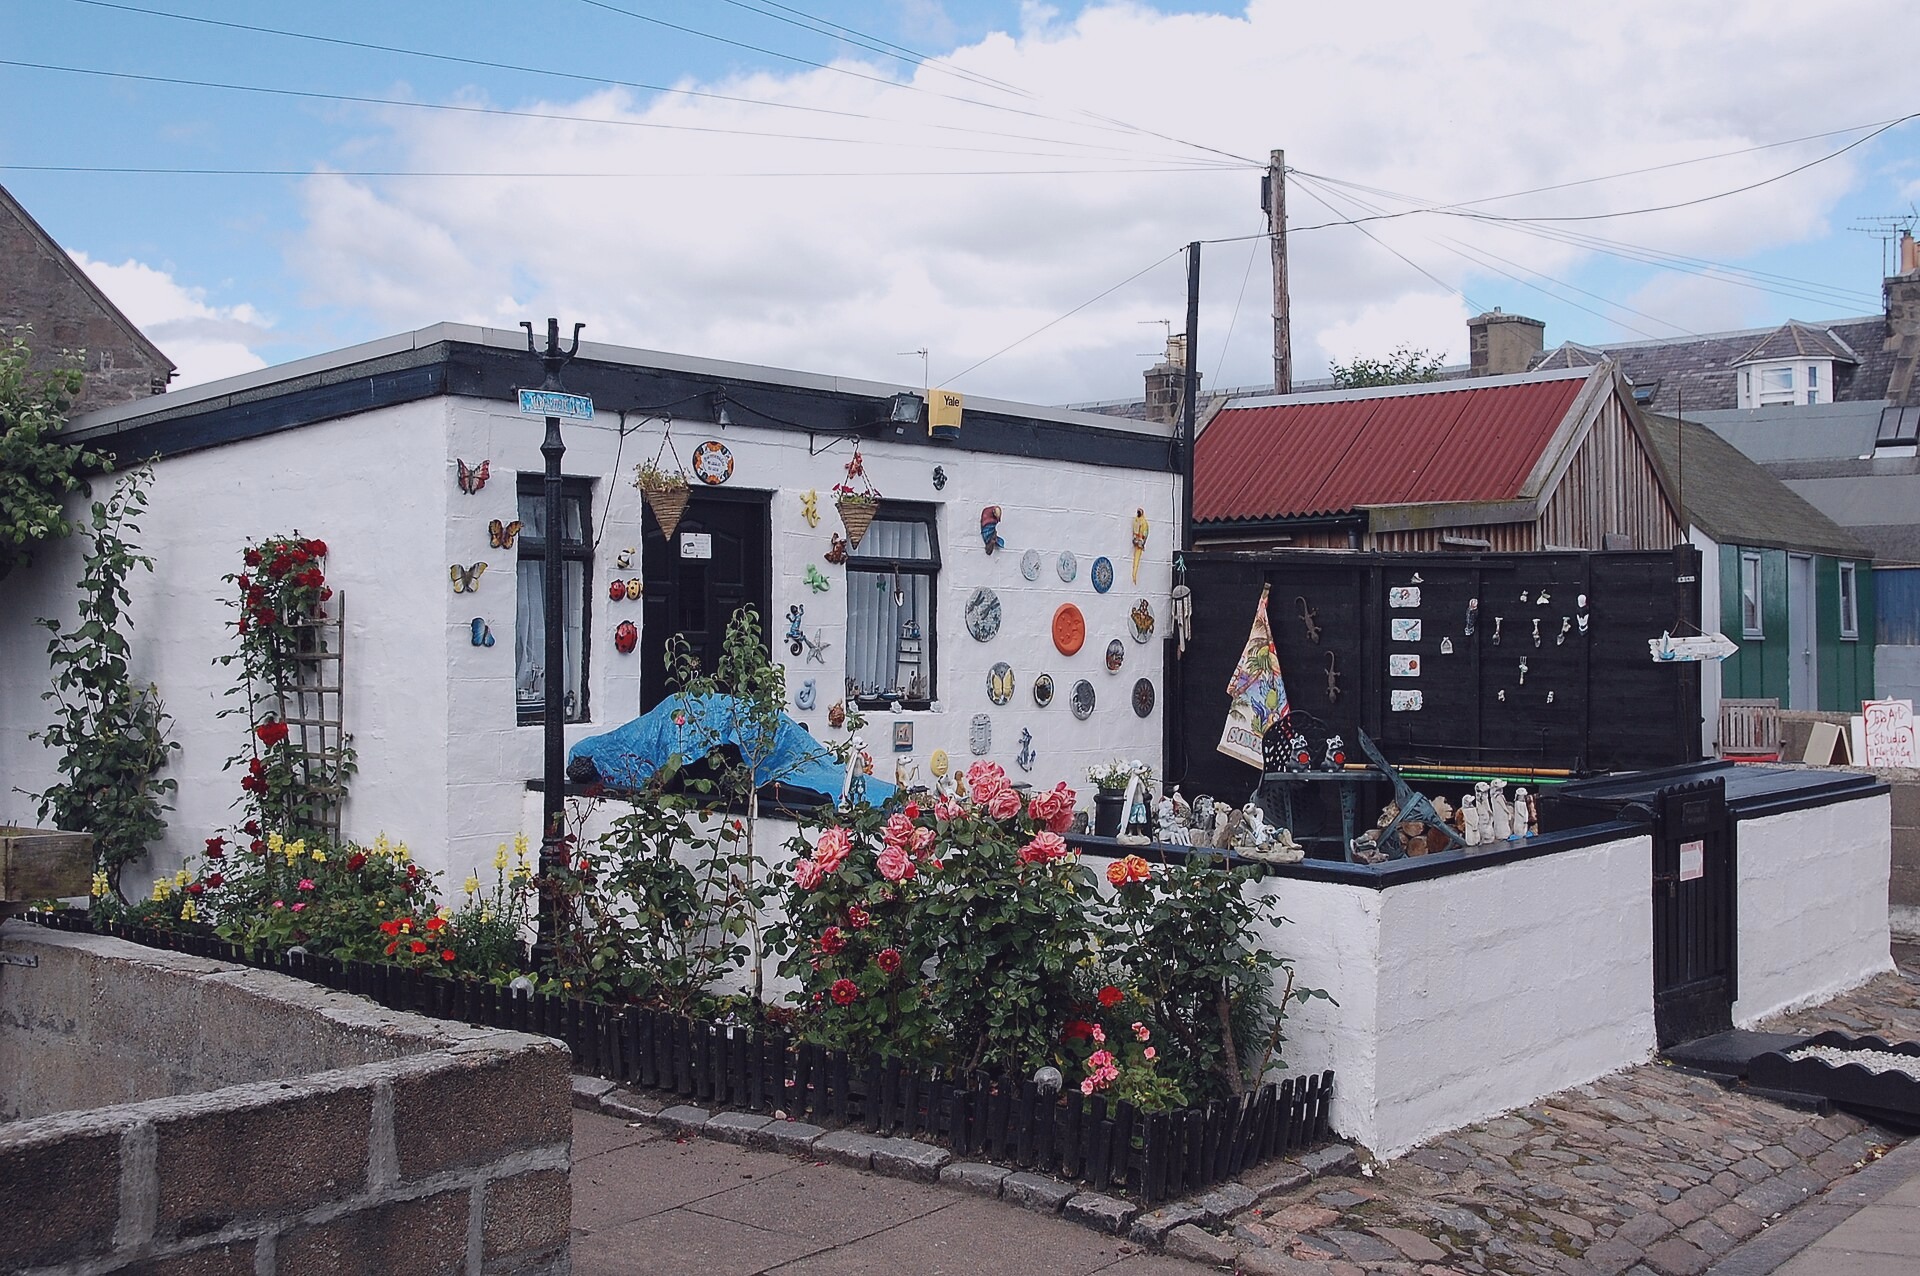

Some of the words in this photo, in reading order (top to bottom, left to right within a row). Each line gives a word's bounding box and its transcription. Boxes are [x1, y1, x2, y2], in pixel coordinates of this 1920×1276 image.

[944, 395, 959, 407] Yale
[1887, 706, 1906, 730] Art
[1874, 731, 1907, 746] Studio
